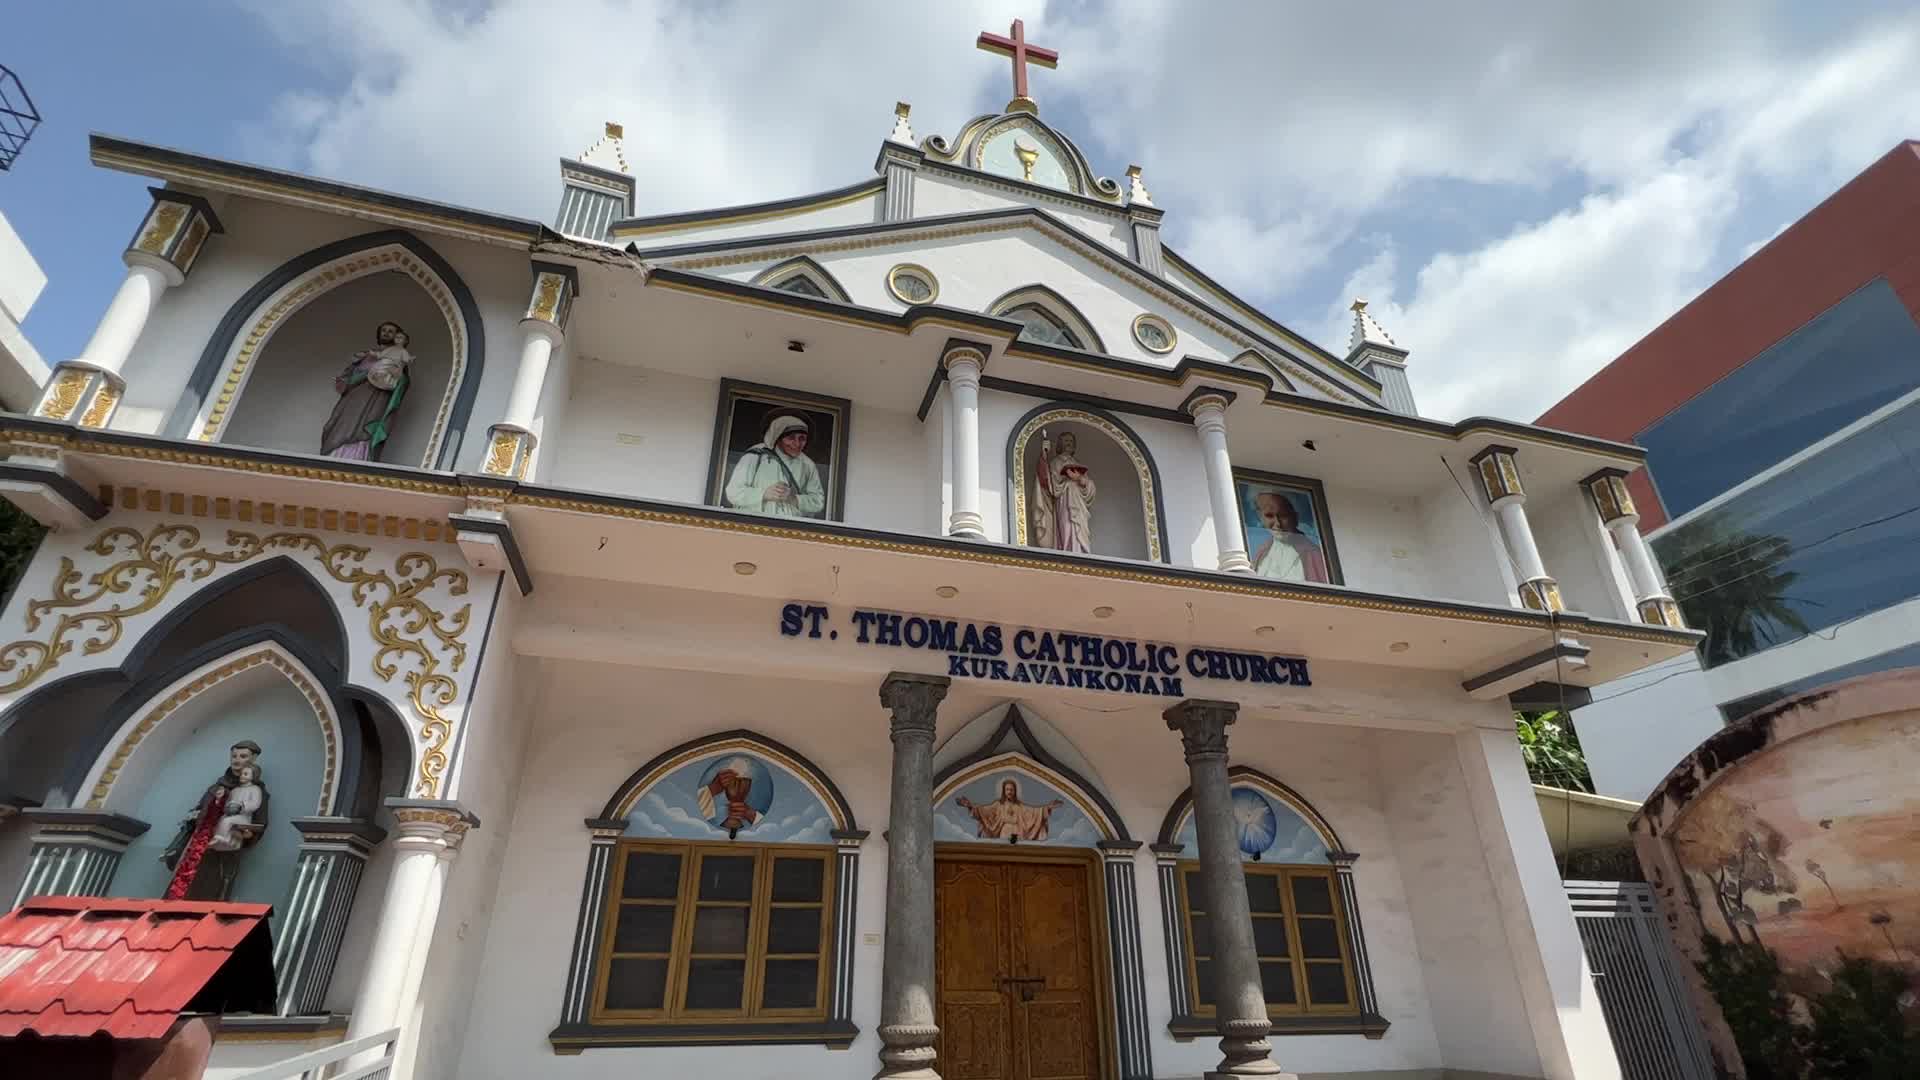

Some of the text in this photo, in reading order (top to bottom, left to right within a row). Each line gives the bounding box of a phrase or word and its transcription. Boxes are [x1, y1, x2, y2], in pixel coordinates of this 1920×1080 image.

[780, 603, 1312, 687] ST. THOMAS CATHOLIC CHURCH
[948, 655, 1184, 697] KURAVANKONAM
